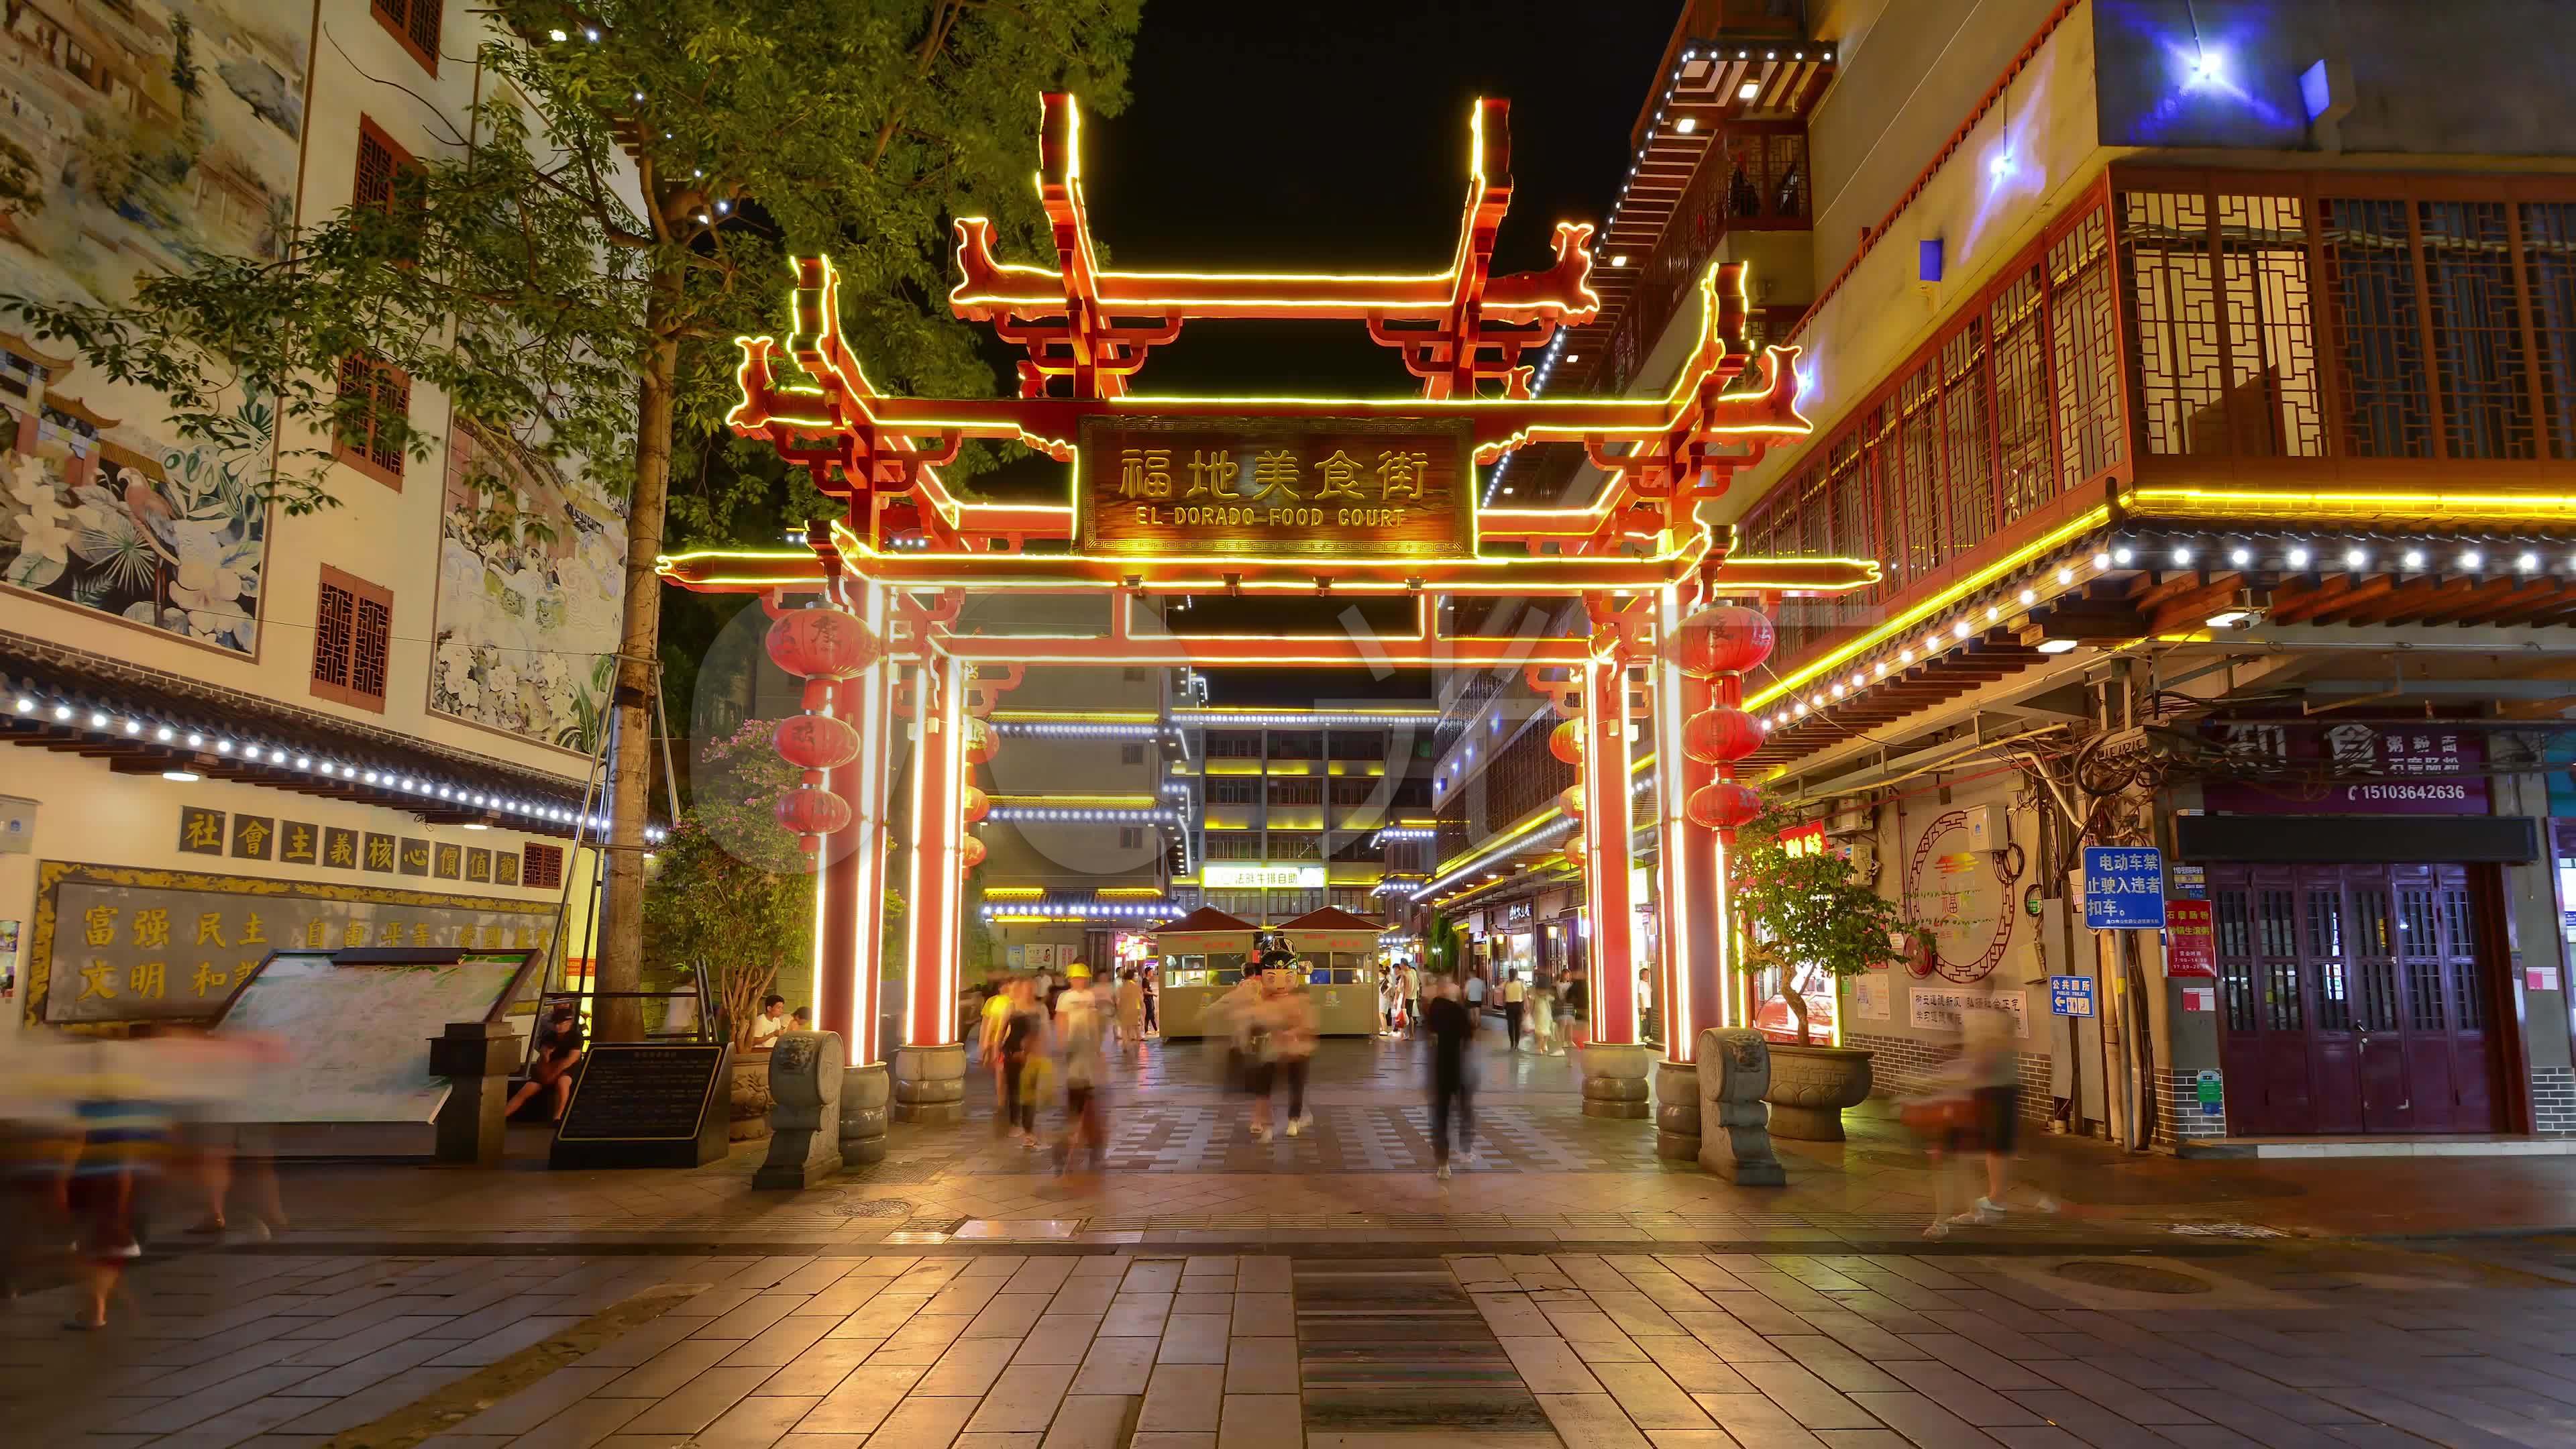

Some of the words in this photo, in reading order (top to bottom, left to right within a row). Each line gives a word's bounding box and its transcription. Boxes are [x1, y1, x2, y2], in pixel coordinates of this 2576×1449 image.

[1118, 449, 1428, 501] 福地美食街
[1136, 506, 1164, 527] EL
[1174, 507, 1254, 527] DORADO
[1269, 508, 1322, 527] FOOD
[1338, 508, 1407, 528] COURT
[2362, 785, 2465, 800] 15103642636
[185, 813, 518, 882] 社會主義核心價值觀
[2099, 853, 2158, 871] 电动车禁
[2086, 876, 2161, 895] 止驶入违者
[85, 904, 170, 947] 富强
[197, 911, 268, 949] 民主
[75, 959, 166, 1001] 文明
